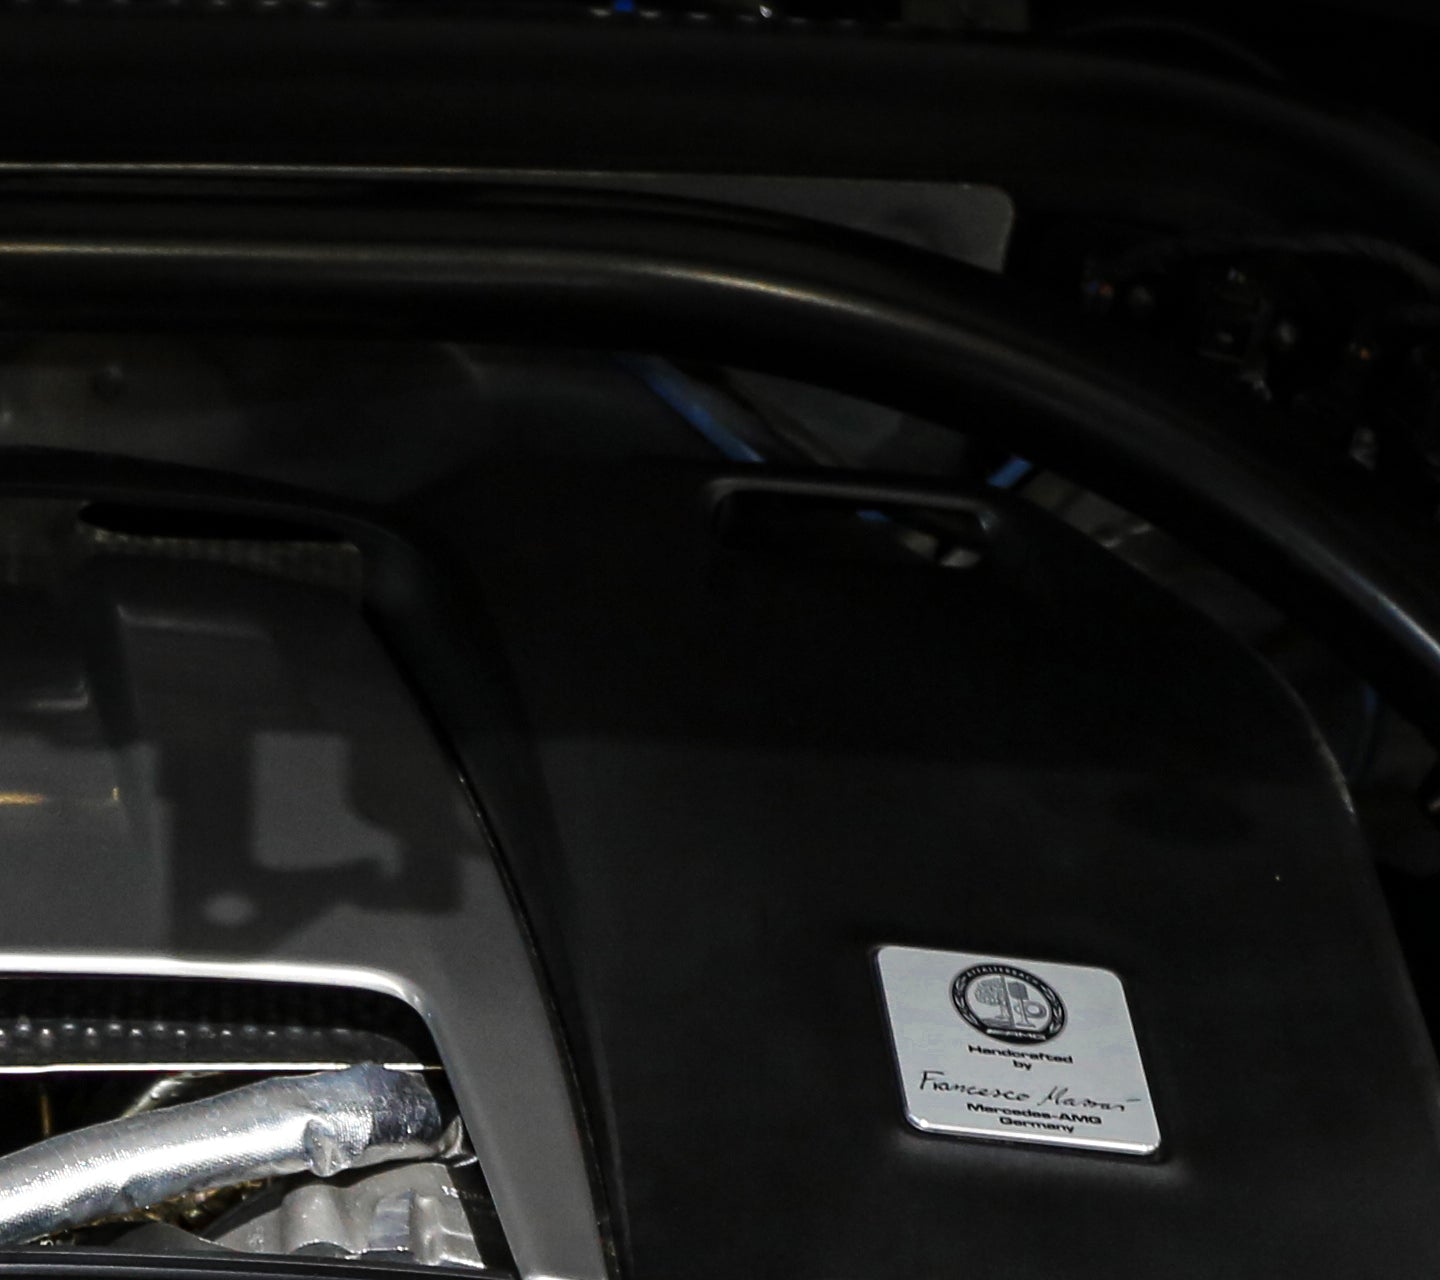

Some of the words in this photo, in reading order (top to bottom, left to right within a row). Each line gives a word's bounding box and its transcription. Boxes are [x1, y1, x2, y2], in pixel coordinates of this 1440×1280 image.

[968, 1045, 1073, 1064] Handcrafted
[1012, 1060, 1032, 1071] by
[919, 1070, 1030, 1102] Francesco
[967, 1103, 1102, 1125] Mercedes-AMG
[999, 1116, 1075, 1134] Germany
